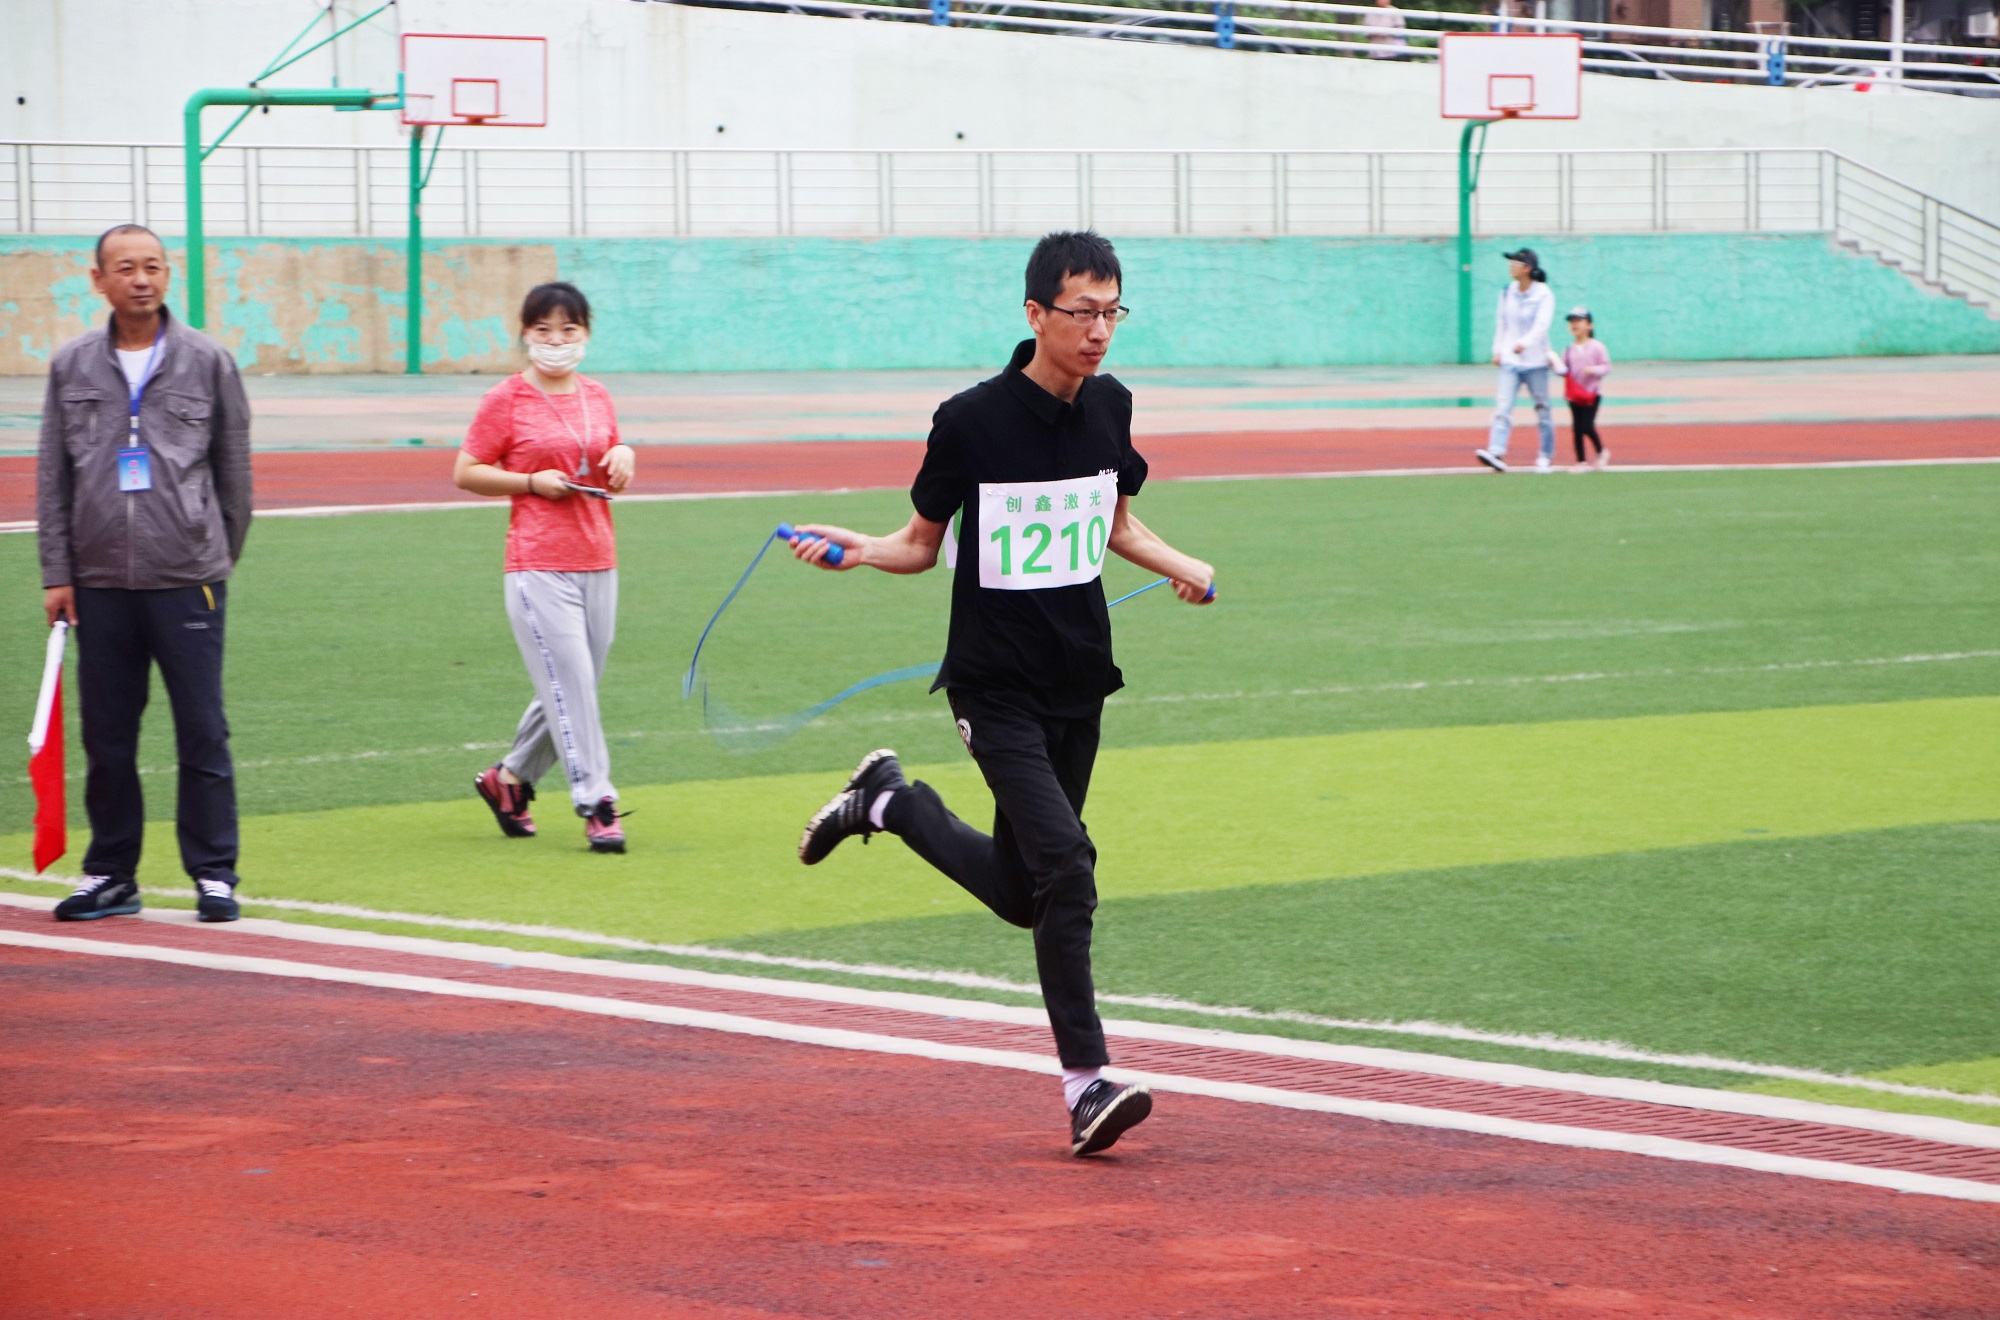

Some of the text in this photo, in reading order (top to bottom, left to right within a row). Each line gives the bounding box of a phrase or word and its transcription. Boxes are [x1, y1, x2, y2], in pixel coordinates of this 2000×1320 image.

[1006, 490, 1101, 513] 创鑫激光
[991, 515, 1106, 576] 1210
